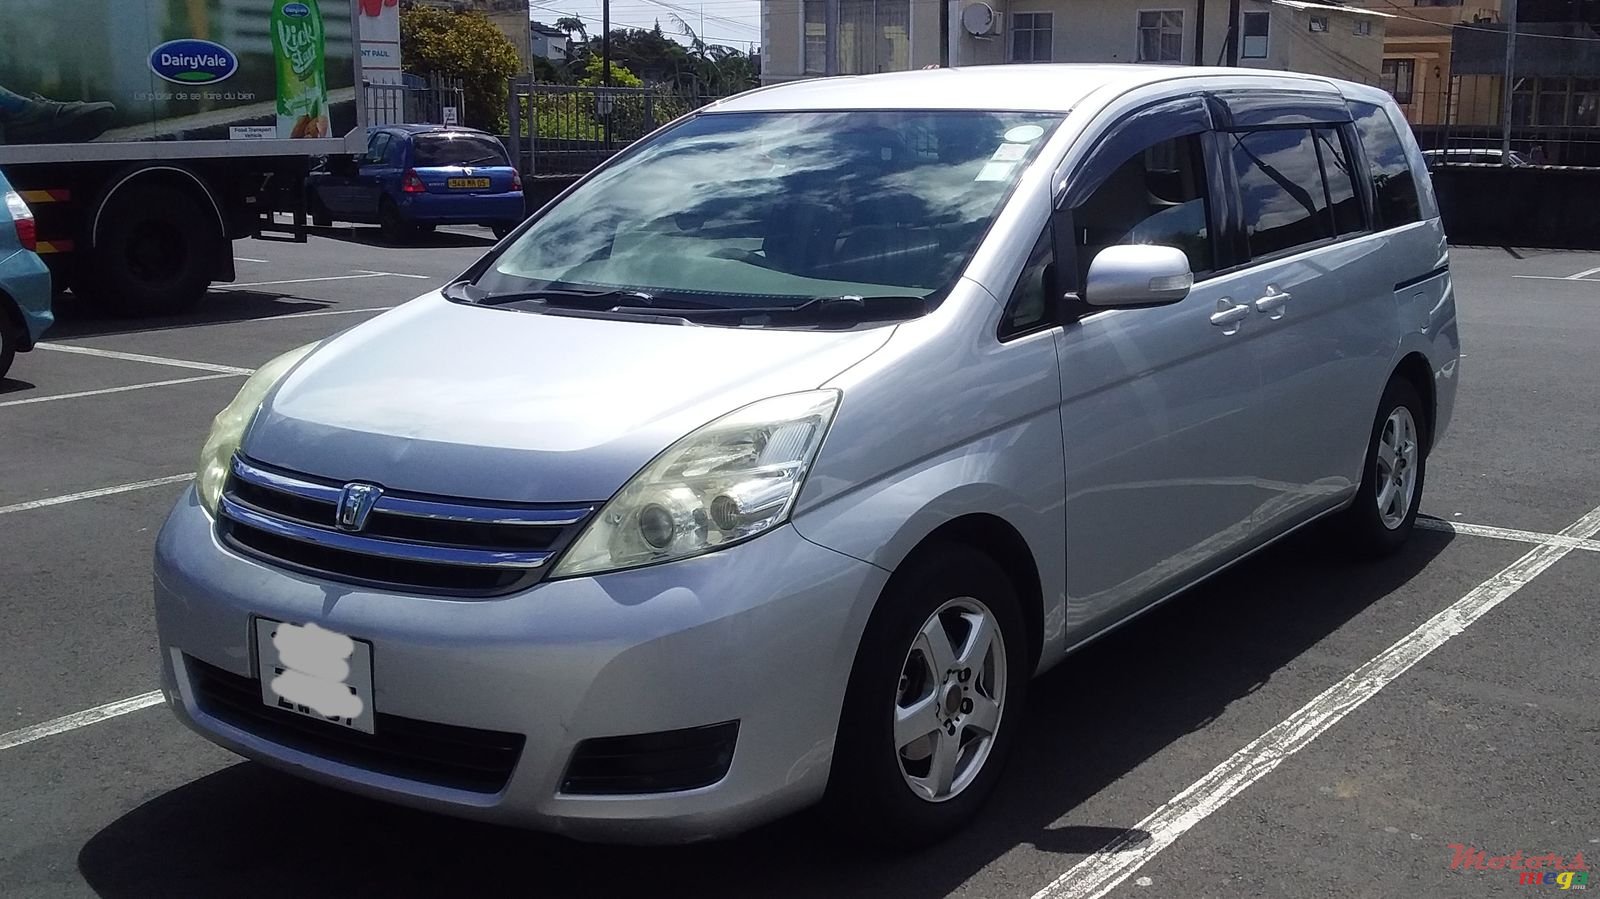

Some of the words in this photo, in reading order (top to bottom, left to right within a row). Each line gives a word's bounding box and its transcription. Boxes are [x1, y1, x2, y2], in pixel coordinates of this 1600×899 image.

[277, 20, 317, 58] Kick
[371, 50, 391, 58] PAUL
[161, 53, 227, 69] DairyVale
[175, 91, 188, 100] de
[223, 91, 236, 100] du
[237, 91, 256, 100] bien
